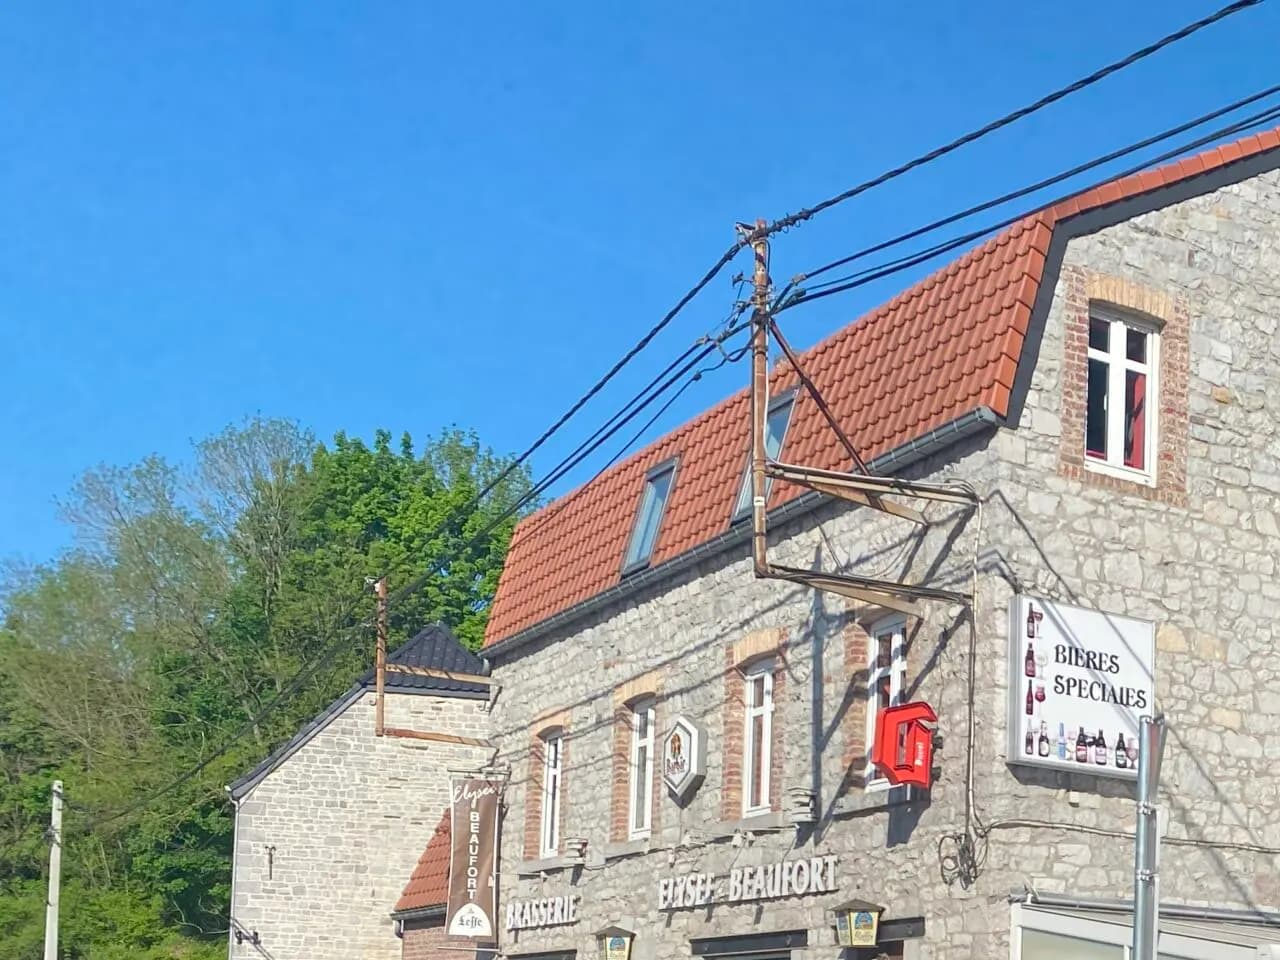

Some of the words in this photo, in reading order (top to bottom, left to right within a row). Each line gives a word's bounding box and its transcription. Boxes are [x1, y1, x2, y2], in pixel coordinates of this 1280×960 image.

[1054, 644, 1120, 674] BIERES
[1054, 675, 1147, 709] SPECIALES
[467, 811, 480, 900] BEAUFORT
[728, 855, 838, 901] BEAUFORT
[457, 915, 483, 930] Leffe
[506, 895, 577, 930] BRASSERIE
